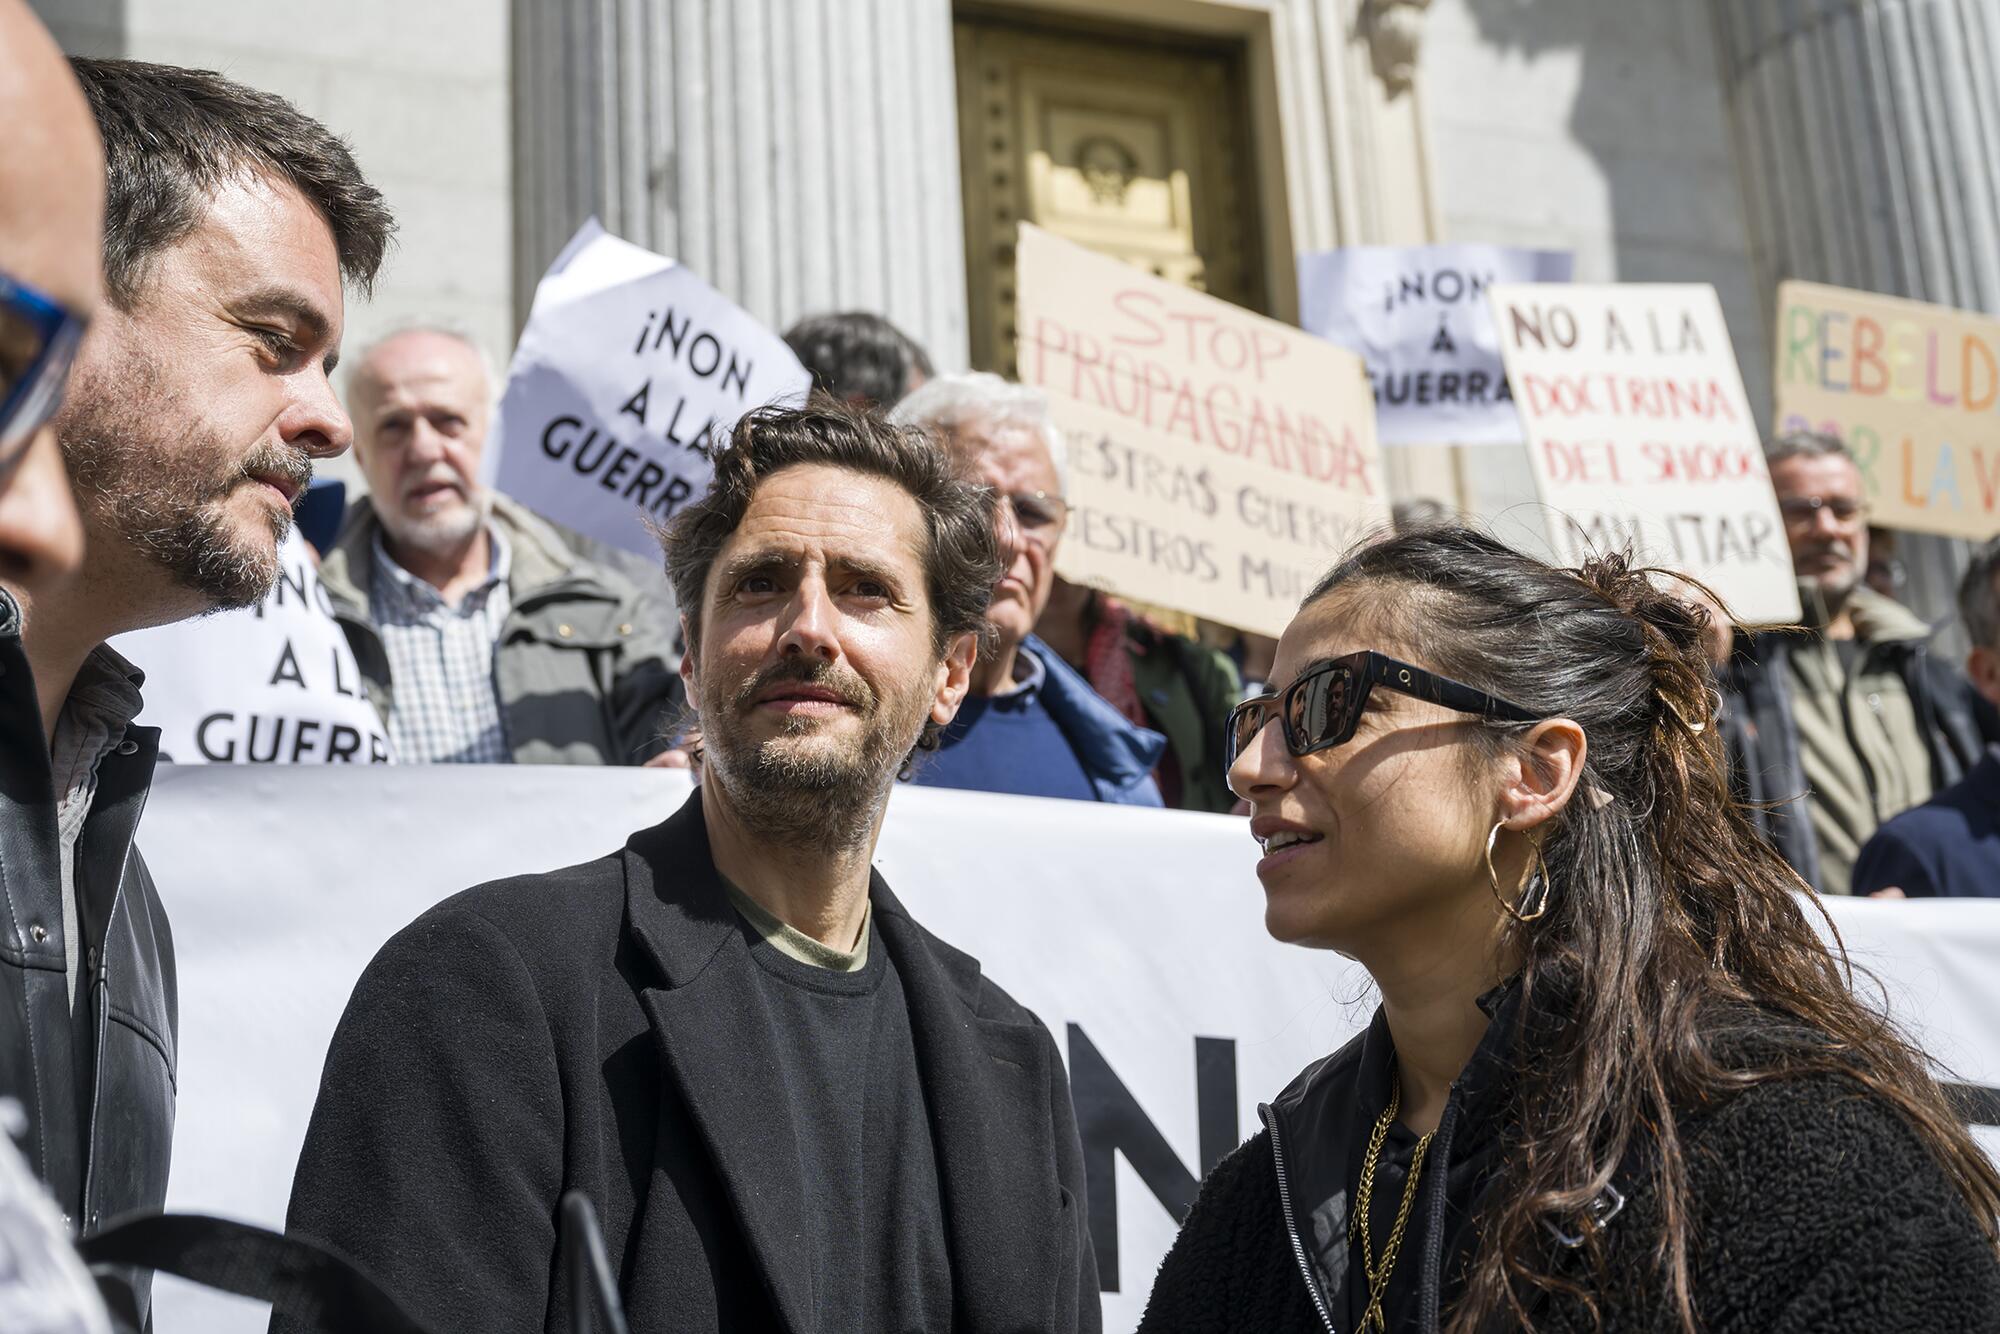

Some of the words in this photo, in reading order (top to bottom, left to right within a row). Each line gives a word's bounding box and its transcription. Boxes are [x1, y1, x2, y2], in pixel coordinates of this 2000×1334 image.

[634, 304, 753, 399] ¡NON
[1111, 289, 1290, 383] STOP
[1509, 304, 1578, 350] NO
[1607, 311, 1634, 354] A
[1647, 310, 1705, 355] LA
[1783, 304, 2000, 413] REBELD
[619, 379, 653, 425] A
[1034, 317, 1376, 497] PROPAGANDA
[1364, 368, 1518, 406] UERRA
[1522, 372, 1738, 423] DOCTRINA
[540, 415, 694, 519] GUERR
[1542, 440, 1626, 485] DEL
[1901, 437, 1963, 511] LA
[268, 638, 308, 690] A
